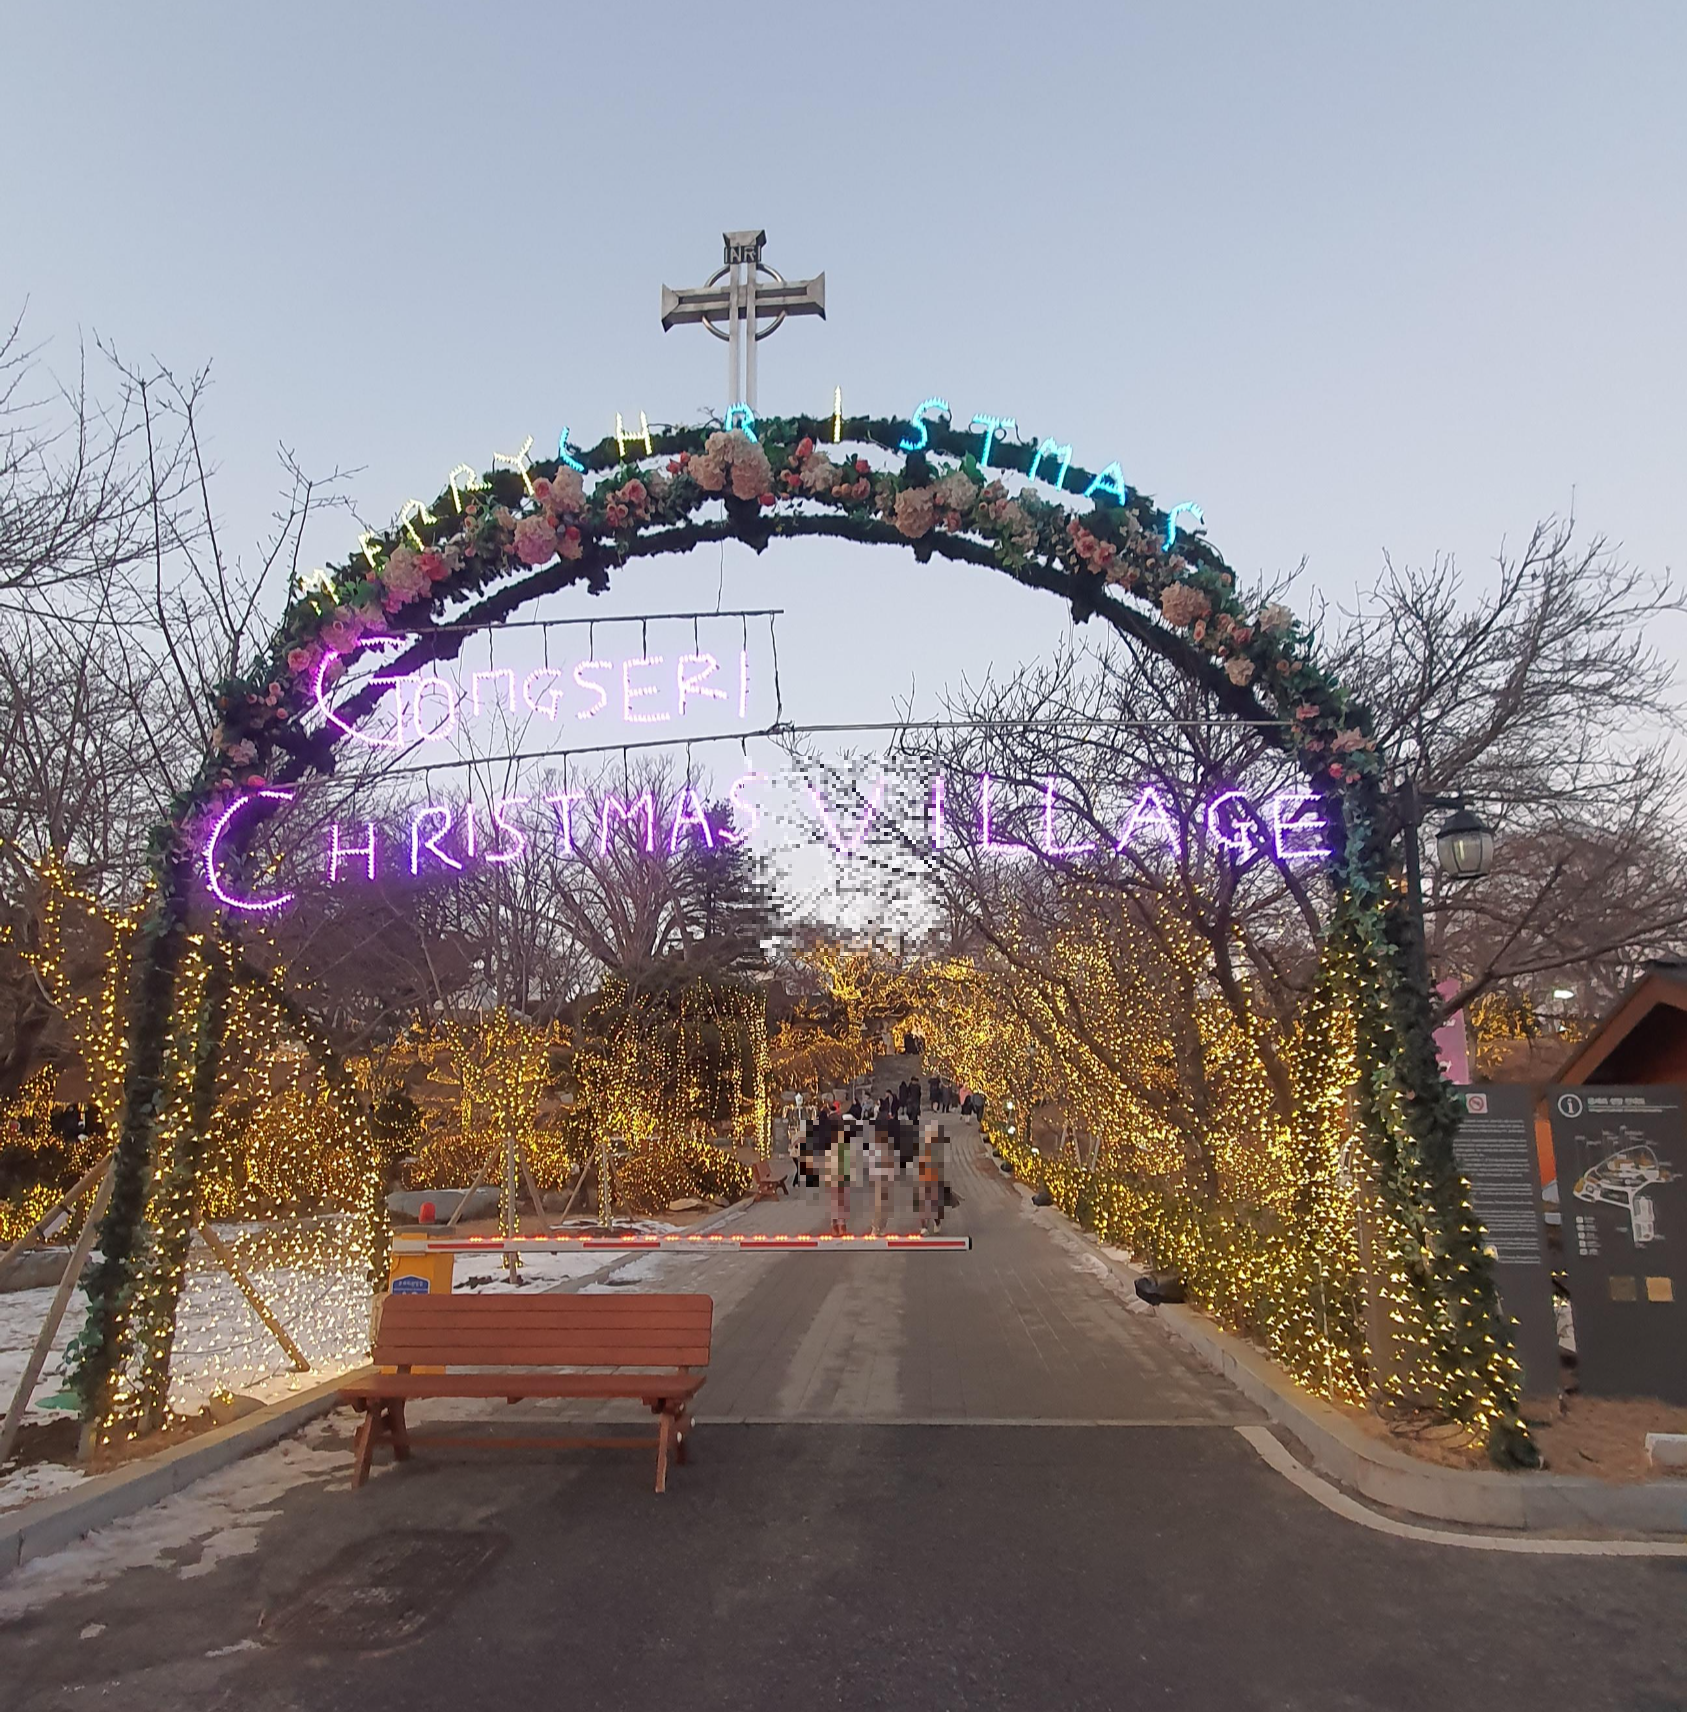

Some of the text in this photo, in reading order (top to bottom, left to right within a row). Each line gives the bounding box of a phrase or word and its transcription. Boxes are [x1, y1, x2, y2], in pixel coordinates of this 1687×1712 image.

[724, 244, 761, 263] INRI
[203, 770, 1333, 911] CHRISTMAS VILLAGE
